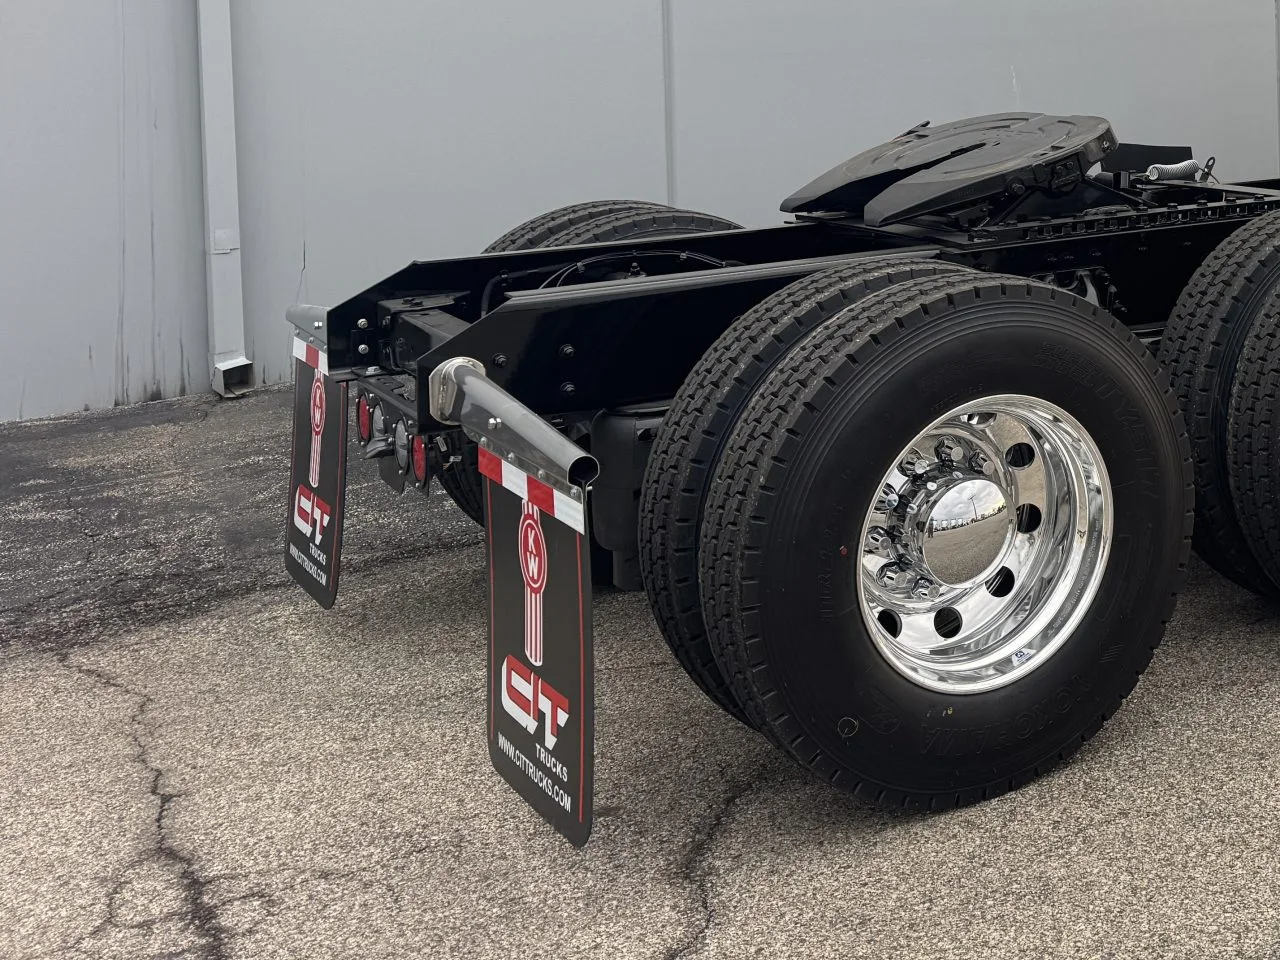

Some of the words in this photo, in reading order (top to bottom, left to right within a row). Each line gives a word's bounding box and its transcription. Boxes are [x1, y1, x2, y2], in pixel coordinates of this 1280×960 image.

[294, 484, 331, 546] CIT
[309, 542, 327, 566] TRUCKS
[502, 654, 569, 751] CIT
[498, 731, 571, 813] WWW.CITTRUCKS.COM
[535, 743, 568, 782] TRUCKS
